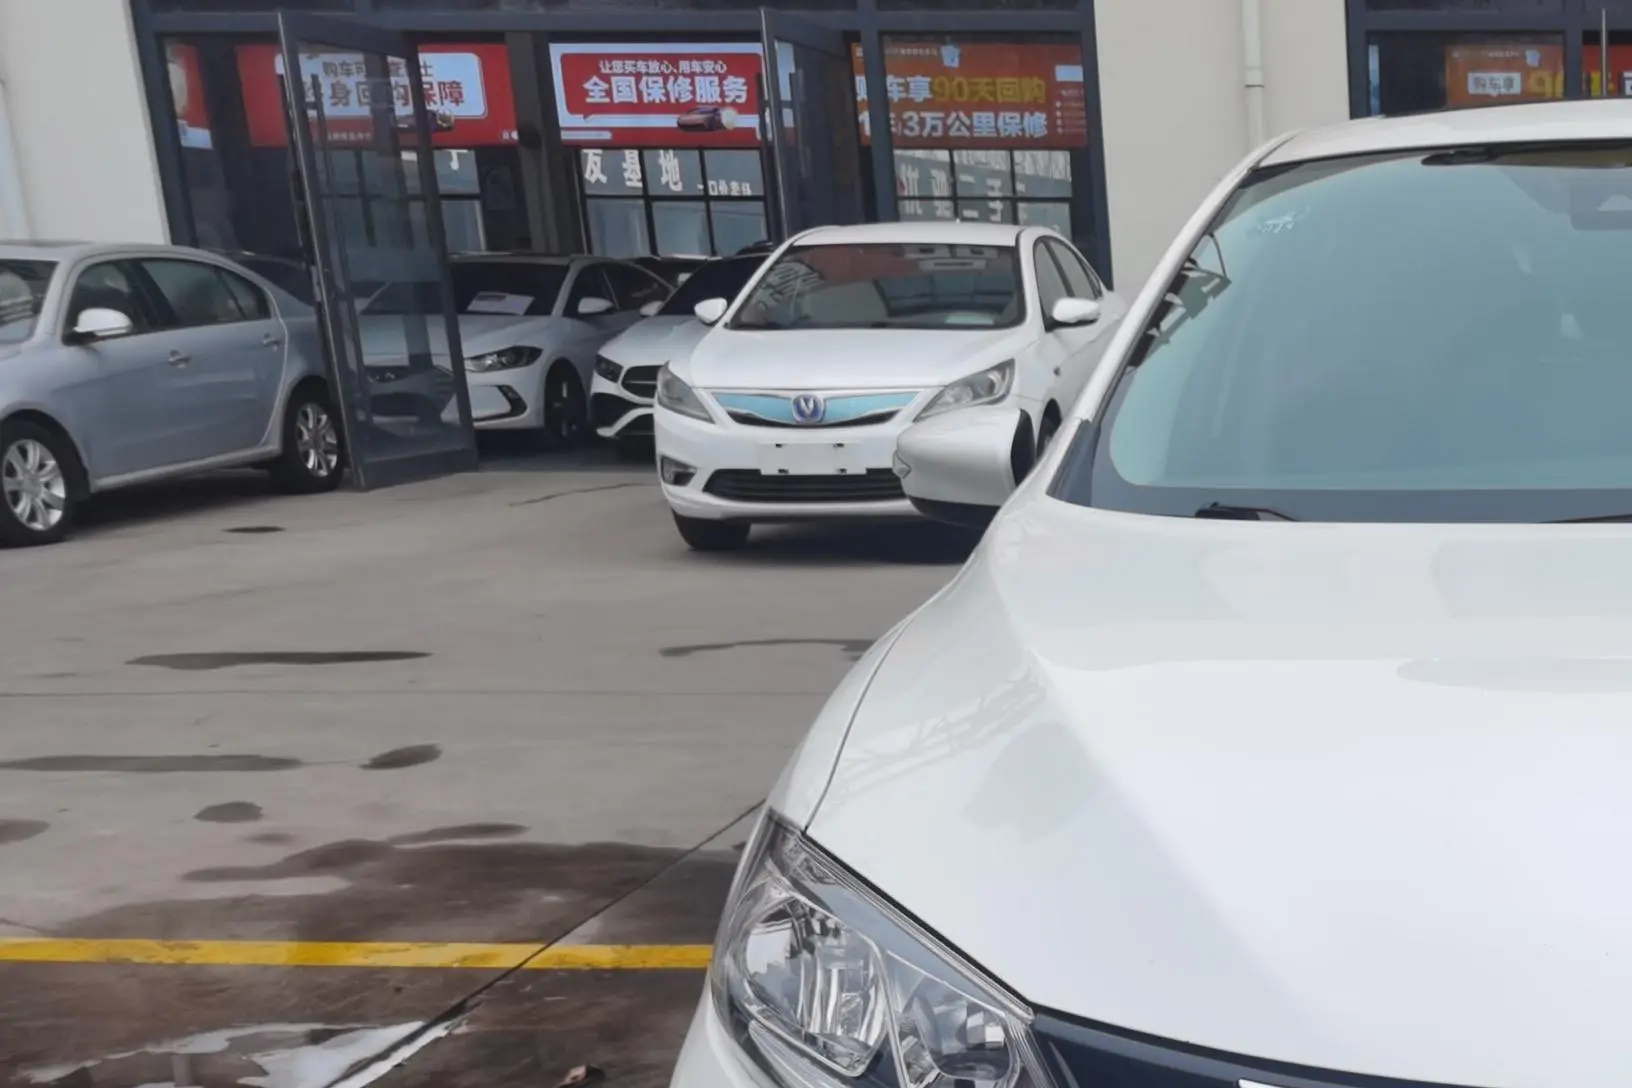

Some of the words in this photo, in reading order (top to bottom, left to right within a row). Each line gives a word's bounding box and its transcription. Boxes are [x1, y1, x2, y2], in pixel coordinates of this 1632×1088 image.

[583, 76, 747, 103] 全国保修服务
